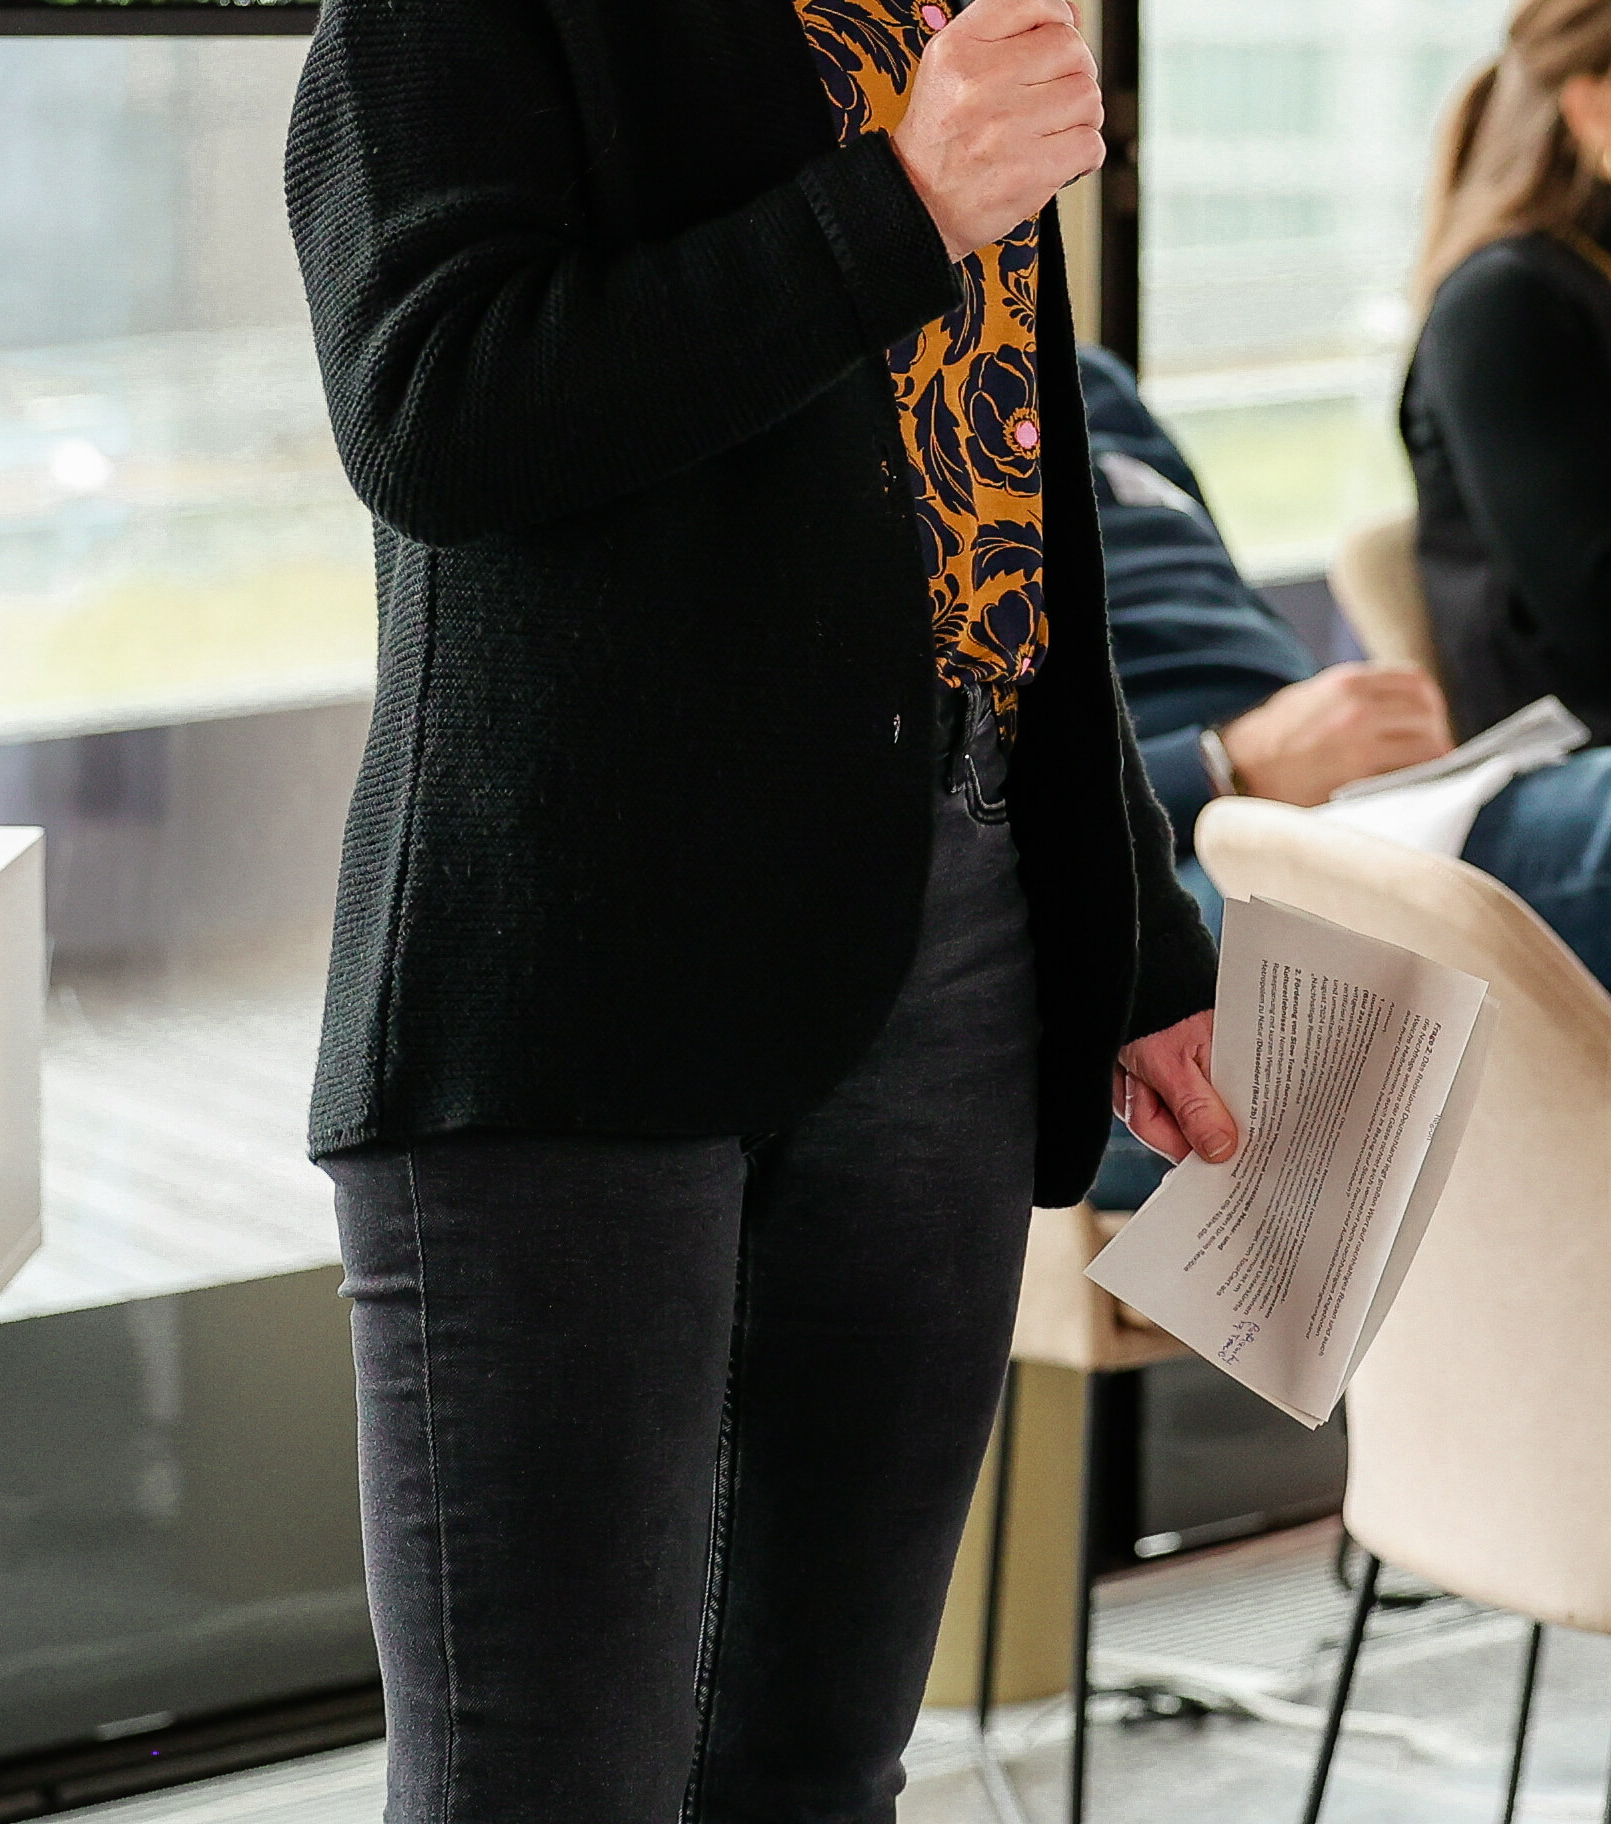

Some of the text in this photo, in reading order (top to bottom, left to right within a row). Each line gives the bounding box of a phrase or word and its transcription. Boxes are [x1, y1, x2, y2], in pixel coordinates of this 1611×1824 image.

[1289, 976, 1302, 1018] Förderung
[1319, 975, 1330, 1003] August
[1318, 1003, 1327, 1024] 2024
[1420, 1017, 1431, 1031] die
[1256, 1014, 1265, 1036] Natur
[1405, 1013, 1421, 1044] Welche
[1425, 1020, 1441, 1047] Frage
[1288, 1035, 1297, 1056] Slow
[1315, 1033, 1323, 1049] den
[1404, 1030, 1426, 1073] Nachfrage
[1285, 1057, 1295, 1082] Travel
[1417, 1054, 1429, 1073] Das
[1281, 1082, 1291, 1107] durch
[1403, 1071, 1424, 1113] Reiseland
[1380, 1096, 1392, 1118] auch
[1391, 1101, 1401, 1115] der
[1382, 1116, 1396, 1141] Gäste
[1385, 1111, 1409, 1163] Deutschland
[1363, 1151, 1373, 1166] auf
[1357, 1164, 1368, 1186] Slow
[1366, 1167, 1378, 1186] sich
[1378, 1161, 1391, 1179] legt
[1348, 1186, 1361, 1210] Travel
[1368, 1177, 1385, 1207] großen
[1343, 1209, 1353, 1226] und
[1362, 1207, 1375, 1227] Wert
[1213, 1225, 1224, 1238] für
[1357, 1226, 1368, 1242] auf
[1216, 1235, 1231, 1252] und
[1338, 1240, 1363, 1291] nachhaltiges
[1330, 1291, 1345, 1320] Reisen
[1324, 1319, 1335, 1336] und
[1317, 1335, 1330, 1357] auch
